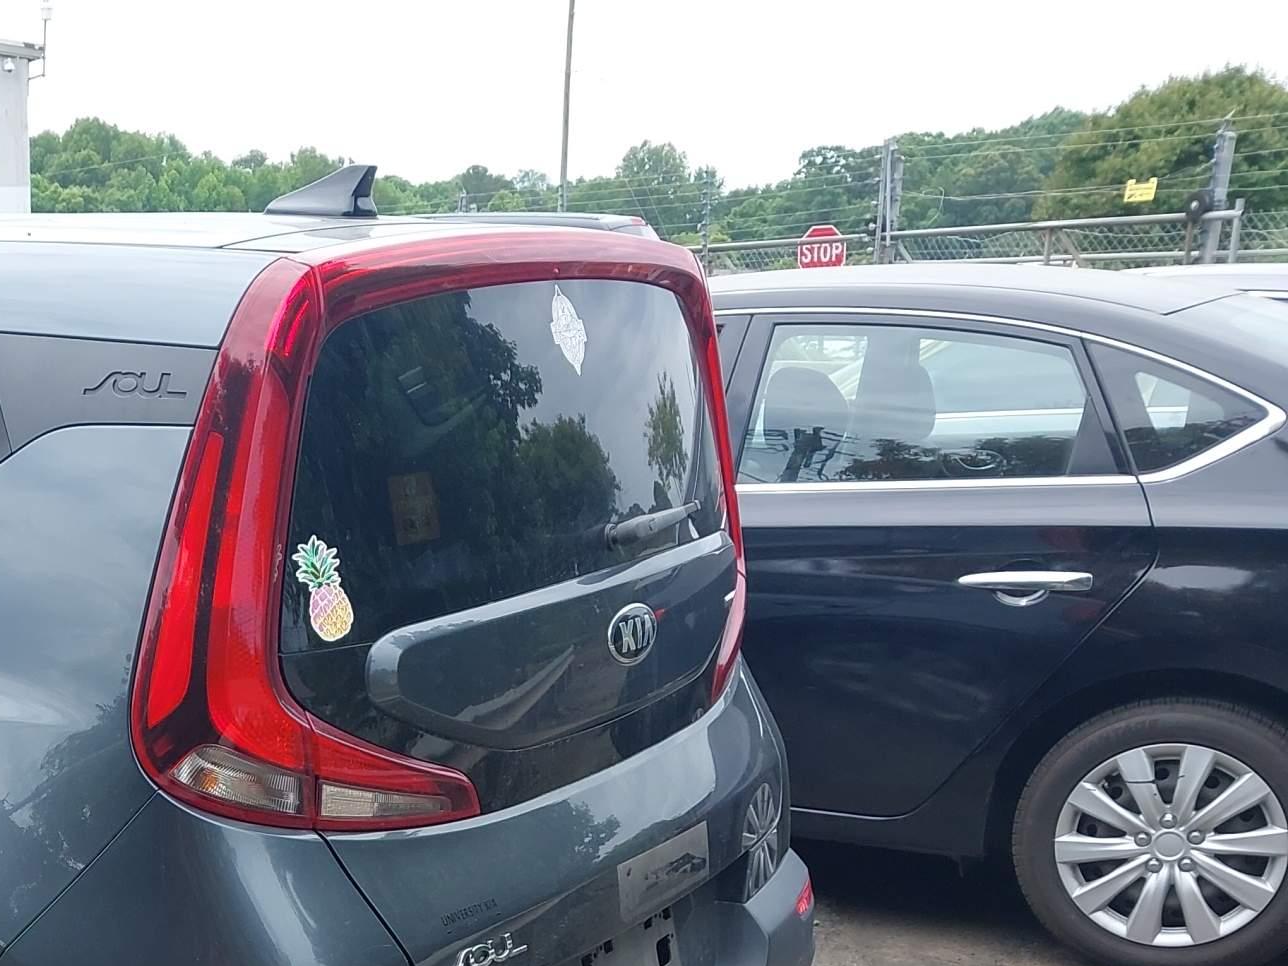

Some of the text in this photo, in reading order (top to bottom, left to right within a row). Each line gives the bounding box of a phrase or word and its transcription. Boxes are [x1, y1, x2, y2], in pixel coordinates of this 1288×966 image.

[801, 242, 843, 264] STOP
[81, 370, 187, 399] SOUL
[618, 613, 654, 654] KIA
